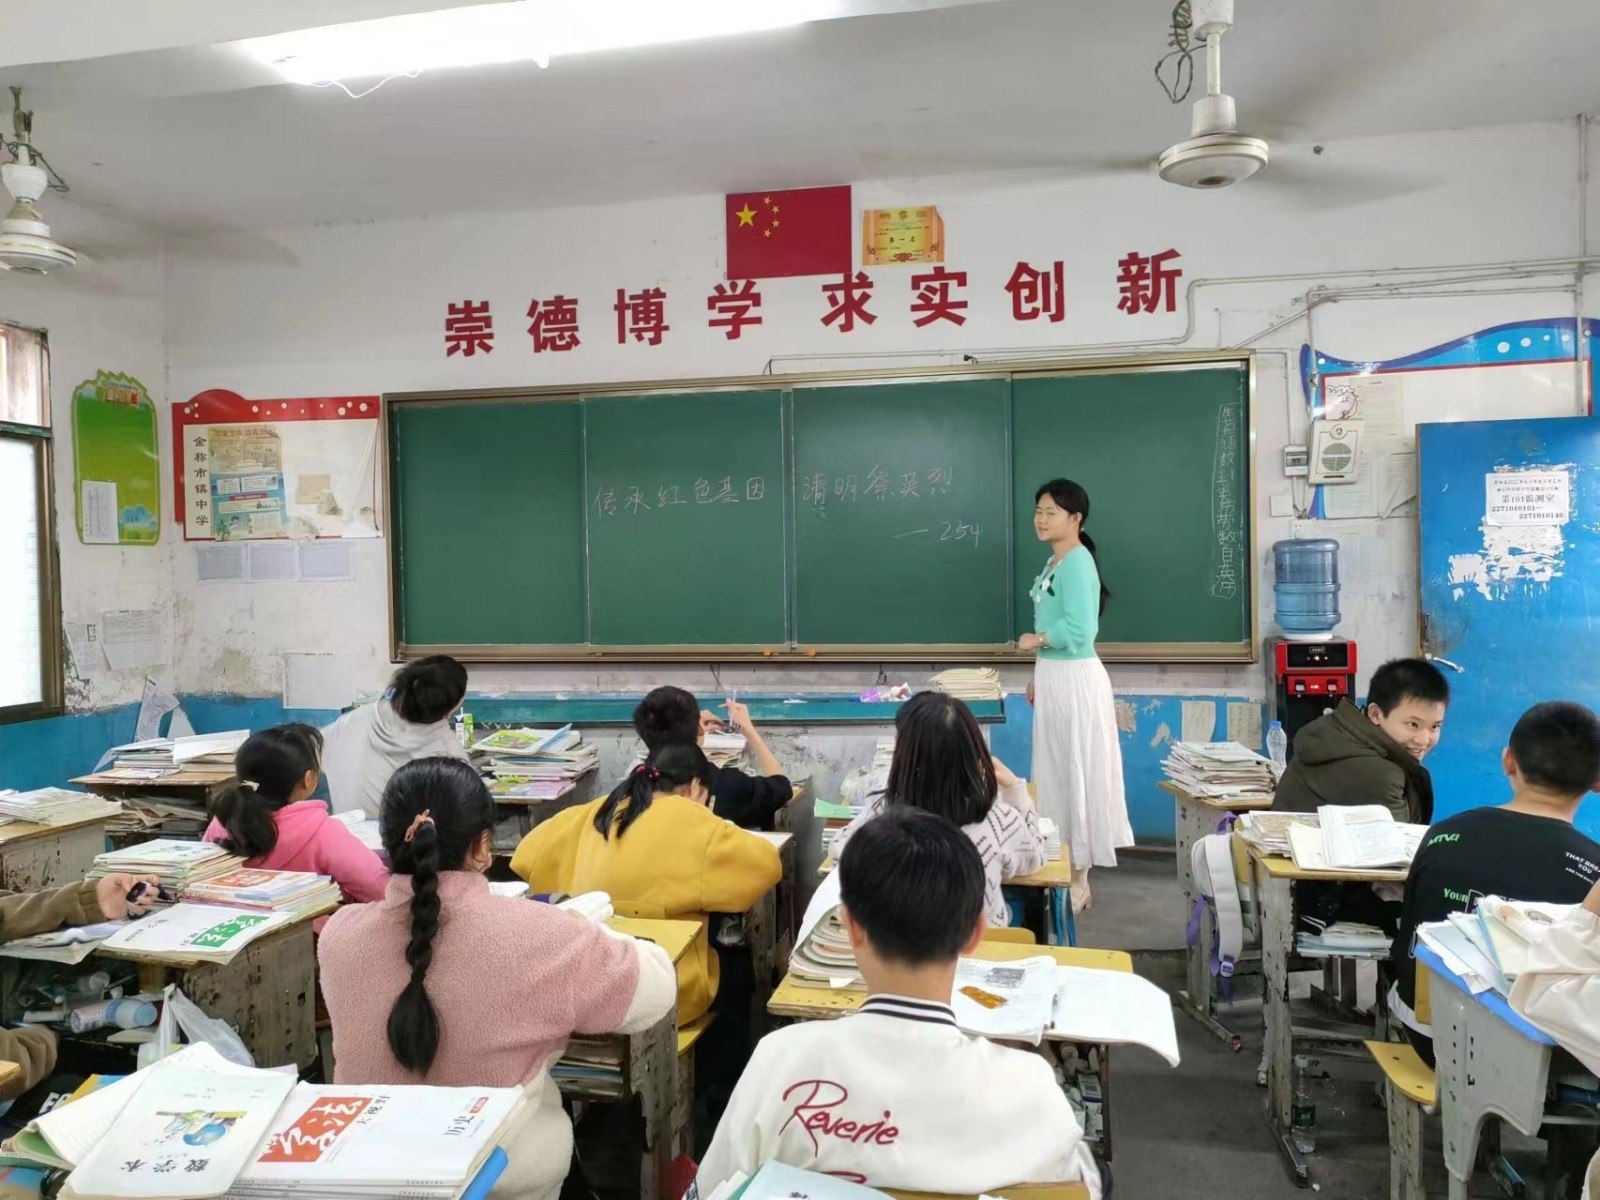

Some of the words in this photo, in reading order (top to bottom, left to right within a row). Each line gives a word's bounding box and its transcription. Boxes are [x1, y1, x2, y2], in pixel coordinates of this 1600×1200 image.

[443, 280, 763, 358] 崇德博学
[819, 248, 1184, 333] 求实创新
[192, 436, 209, 526] 金称市镇中学
[592, 475, 765, 519] 传承红色基因
[1501, 493, 1556, 504] 第101监测室
[1518, 512, 1564, 520] 2271010140
[1565, 851, 1585, 863] THAT
[1578, 863, 1593, 874] YOU
[777, 1079, 899, 1158] Reverie
[119, 1158, 210, 1174] 数学本
